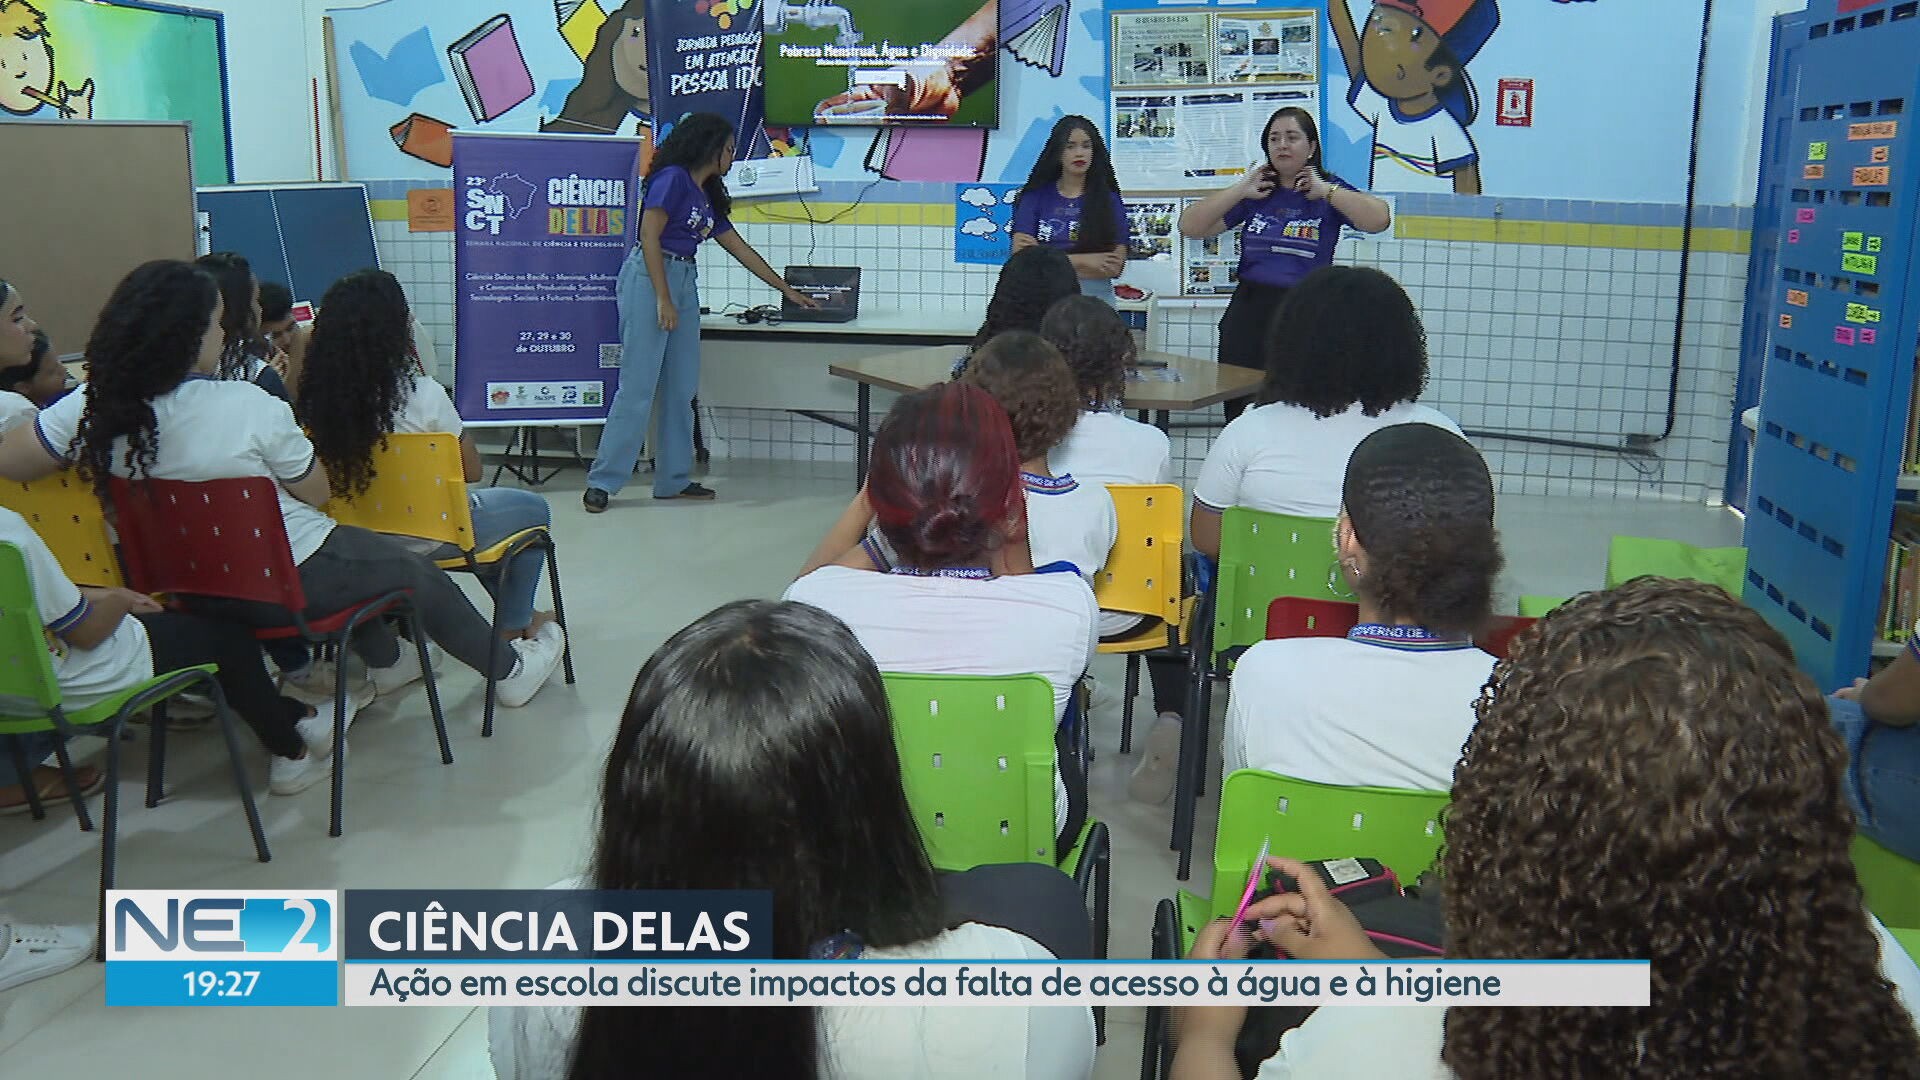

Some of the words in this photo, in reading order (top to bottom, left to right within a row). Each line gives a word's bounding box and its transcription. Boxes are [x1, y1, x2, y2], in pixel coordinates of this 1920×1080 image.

[676, 36, 718, 53] JORNADA
[779, 45, 821, 58] Pobreza
[824, 44, 877, 59] Menstrual,
[881, 40, 908, 60] Água
[911, 48, 918, 57] e
[685, 54, 704, 71] EM
[707, 46, 756, 69] ATENÇÃO
[671, 69, 729, 97] PESSOA
[547, 174, 626, 206] CIÊNCIA
[548, 208, 625, 236] DELAS
[543, 240, 572, 249] CIÊNCIA
[519, 332, 535, 341] 27,
[538, 332, 549, 340] 29
[559, 332, 572, 340] 30
[516, 345, 528, 353] de
[530, 345, 576, 353] OUTUBRO
